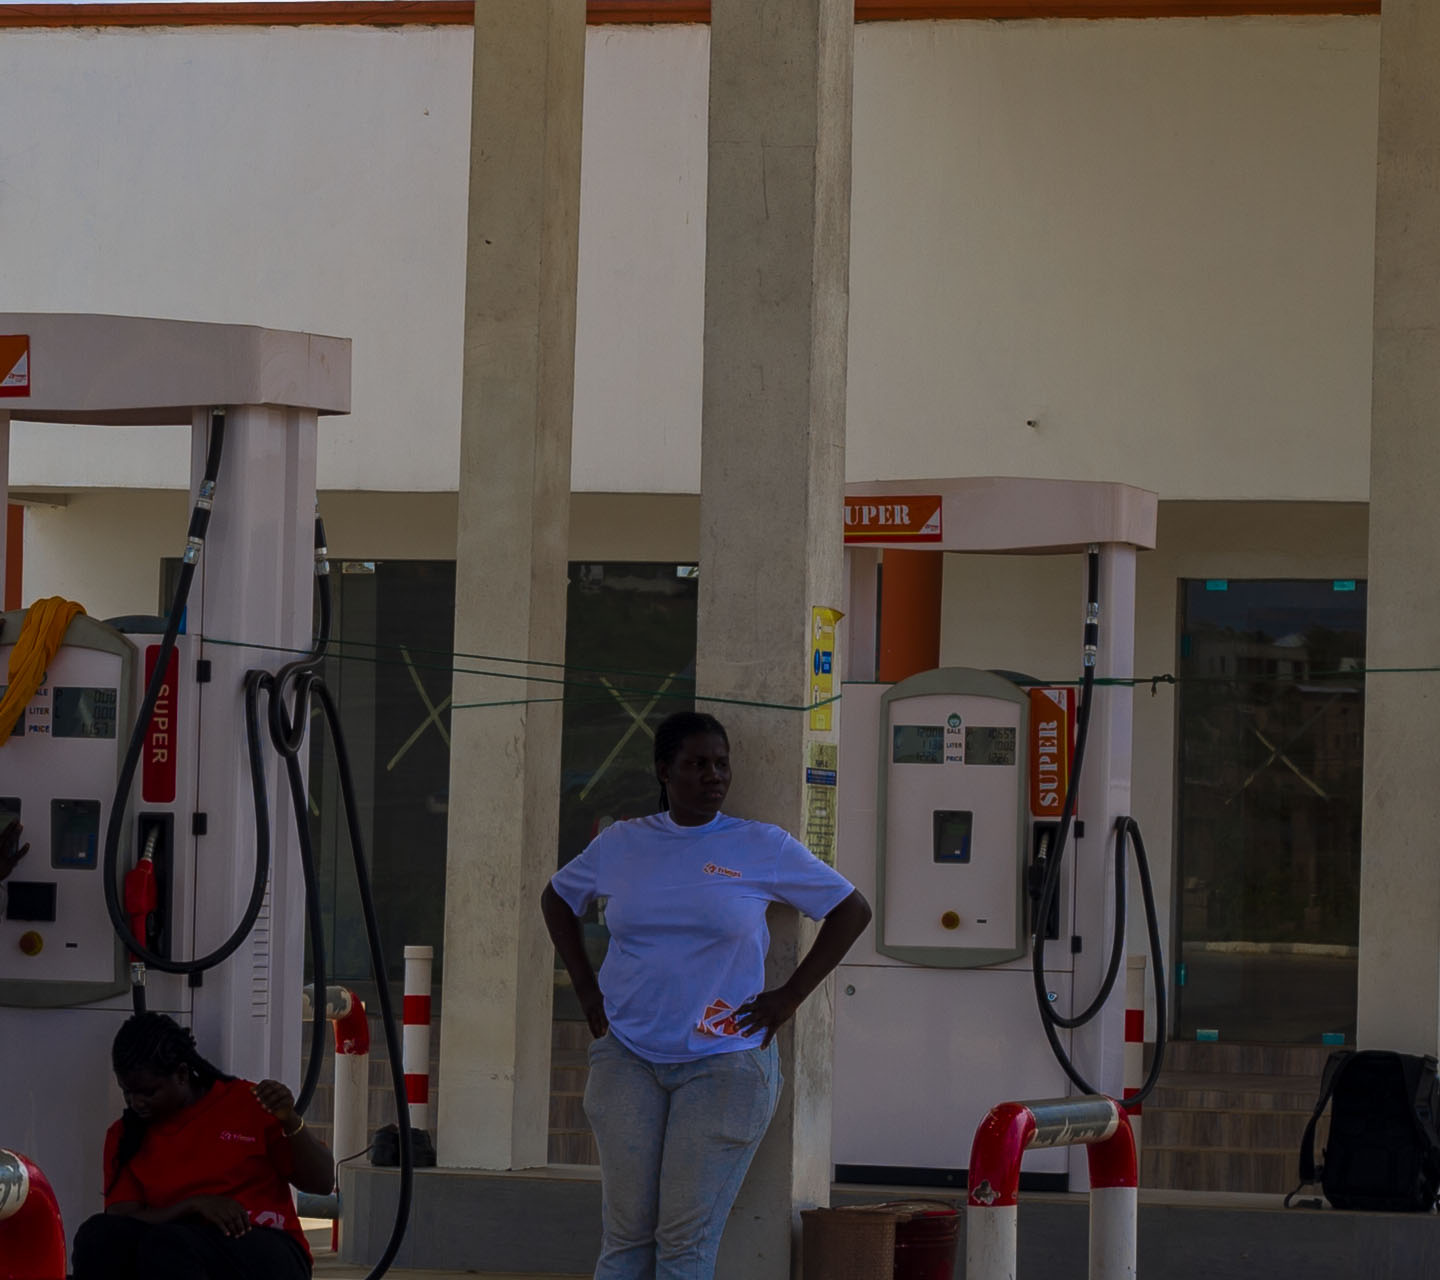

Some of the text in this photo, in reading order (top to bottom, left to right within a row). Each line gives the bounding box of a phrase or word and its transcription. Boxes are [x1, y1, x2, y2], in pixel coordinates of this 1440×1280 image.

[843, 504, 911, 526] UPER
[35, 688, 48, 696] ALE
[29, 706, 49, 715] LITER
[152, 684, 169, 763] SUPER
[28, 724, 50, 733] PRICE
[946, 727, 961, 735] SALE
[1038, 720, 1059, 807] SUPER
